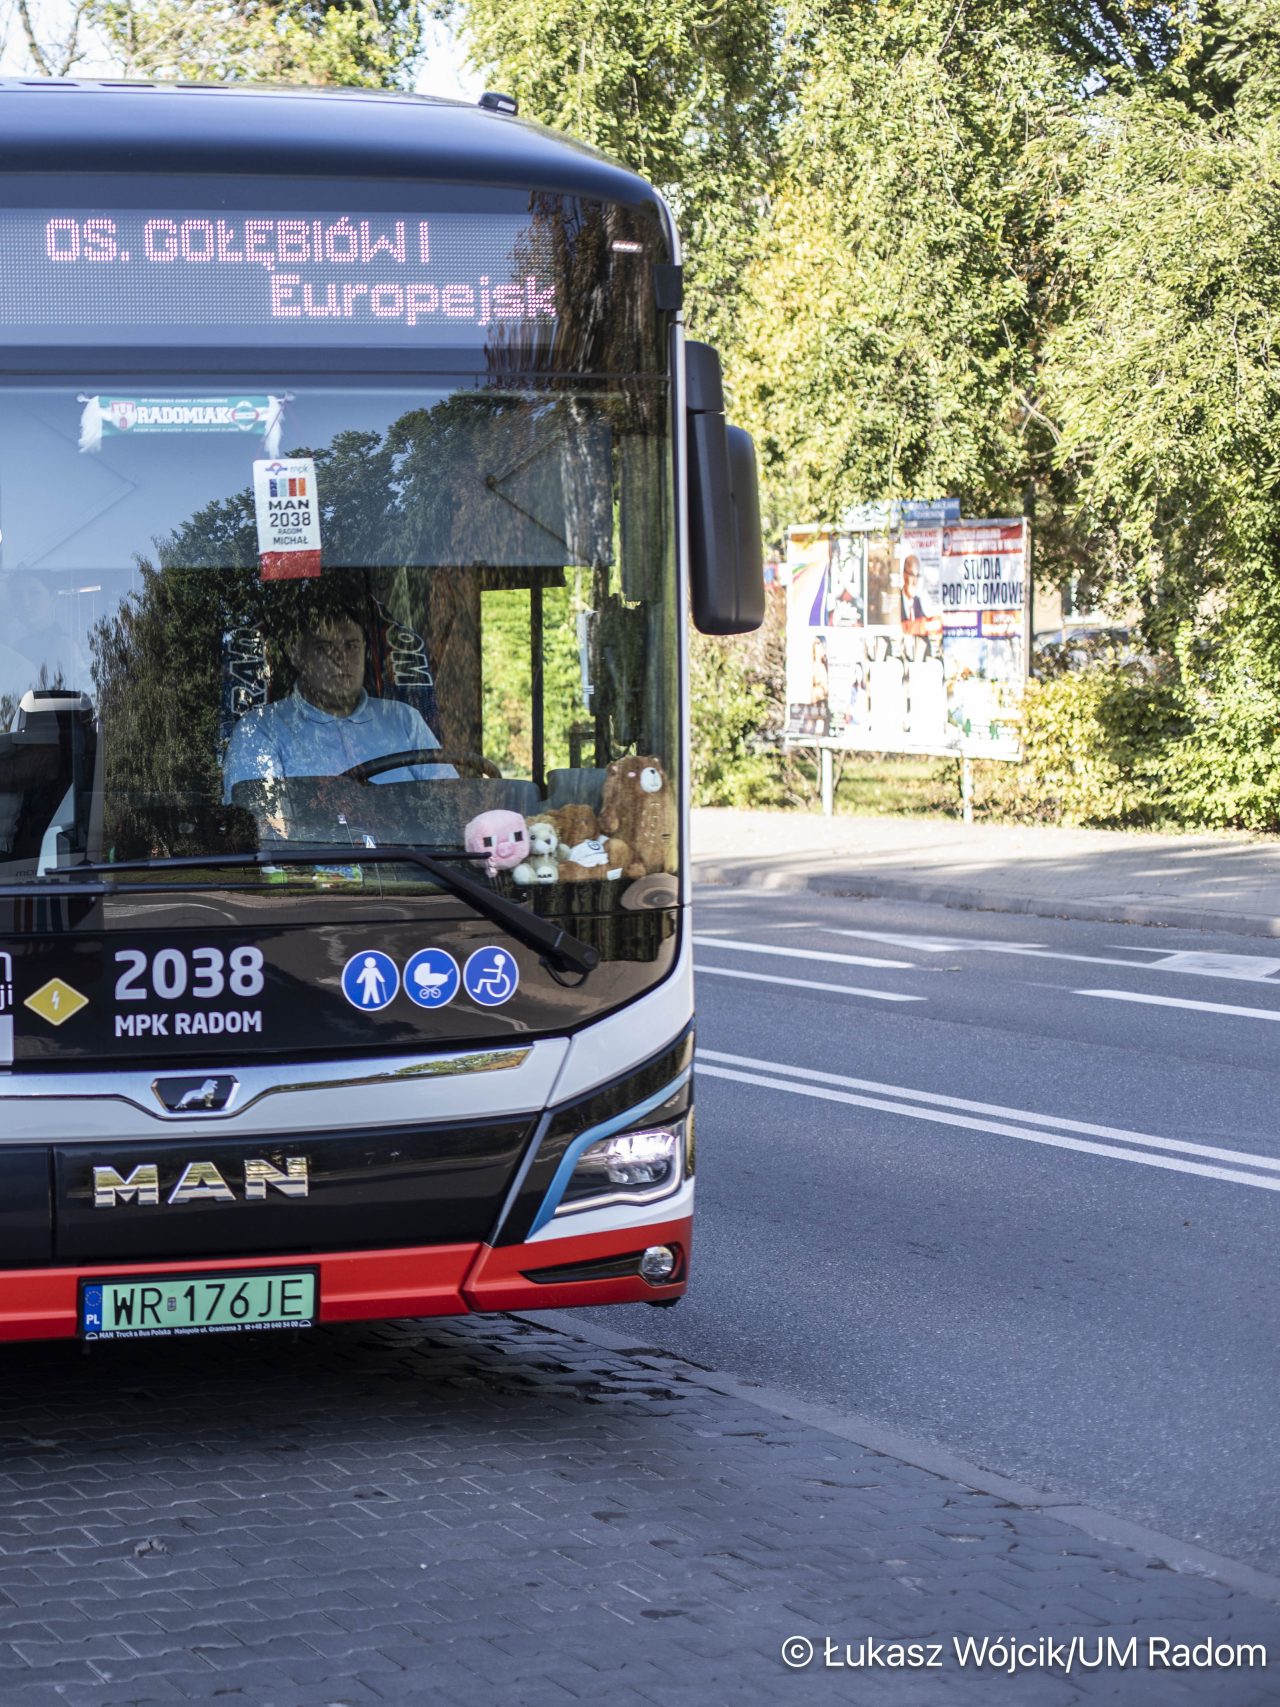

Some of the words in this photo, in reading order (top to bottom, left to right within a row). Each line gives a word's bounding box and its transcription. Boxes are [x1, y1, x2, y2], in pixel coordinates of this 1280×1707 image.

[46, 218, 130, 262] OS.
[144, 216, 407, 271] GOŁĘBIÓW
[271, 275, 557, 326] Europejsk
[136, 406, 232, 424] RADOMIAK
[269, 499, 310, 511] MAN
[269, 511, 311, 527] 2038
[963, 557, 1002, 580] STUDIA
[942, 582, 1024, 605] PODYPLOMOWE
[115, 946, 265, 1000] 2038
[115, 1013, 169, 1037] MPK
[174, 1010, 262, 1035] RADOM
[93, 1157, 309, 1207] MAN
[113, 1286, 163, 1326] WR
[183, 1279, 304, 1322] 176JE
[86, 1314, 100, 1326] PL
[116, 1330, 133, 1338] Truck
[139, 1329, 150, 1337] Bus
